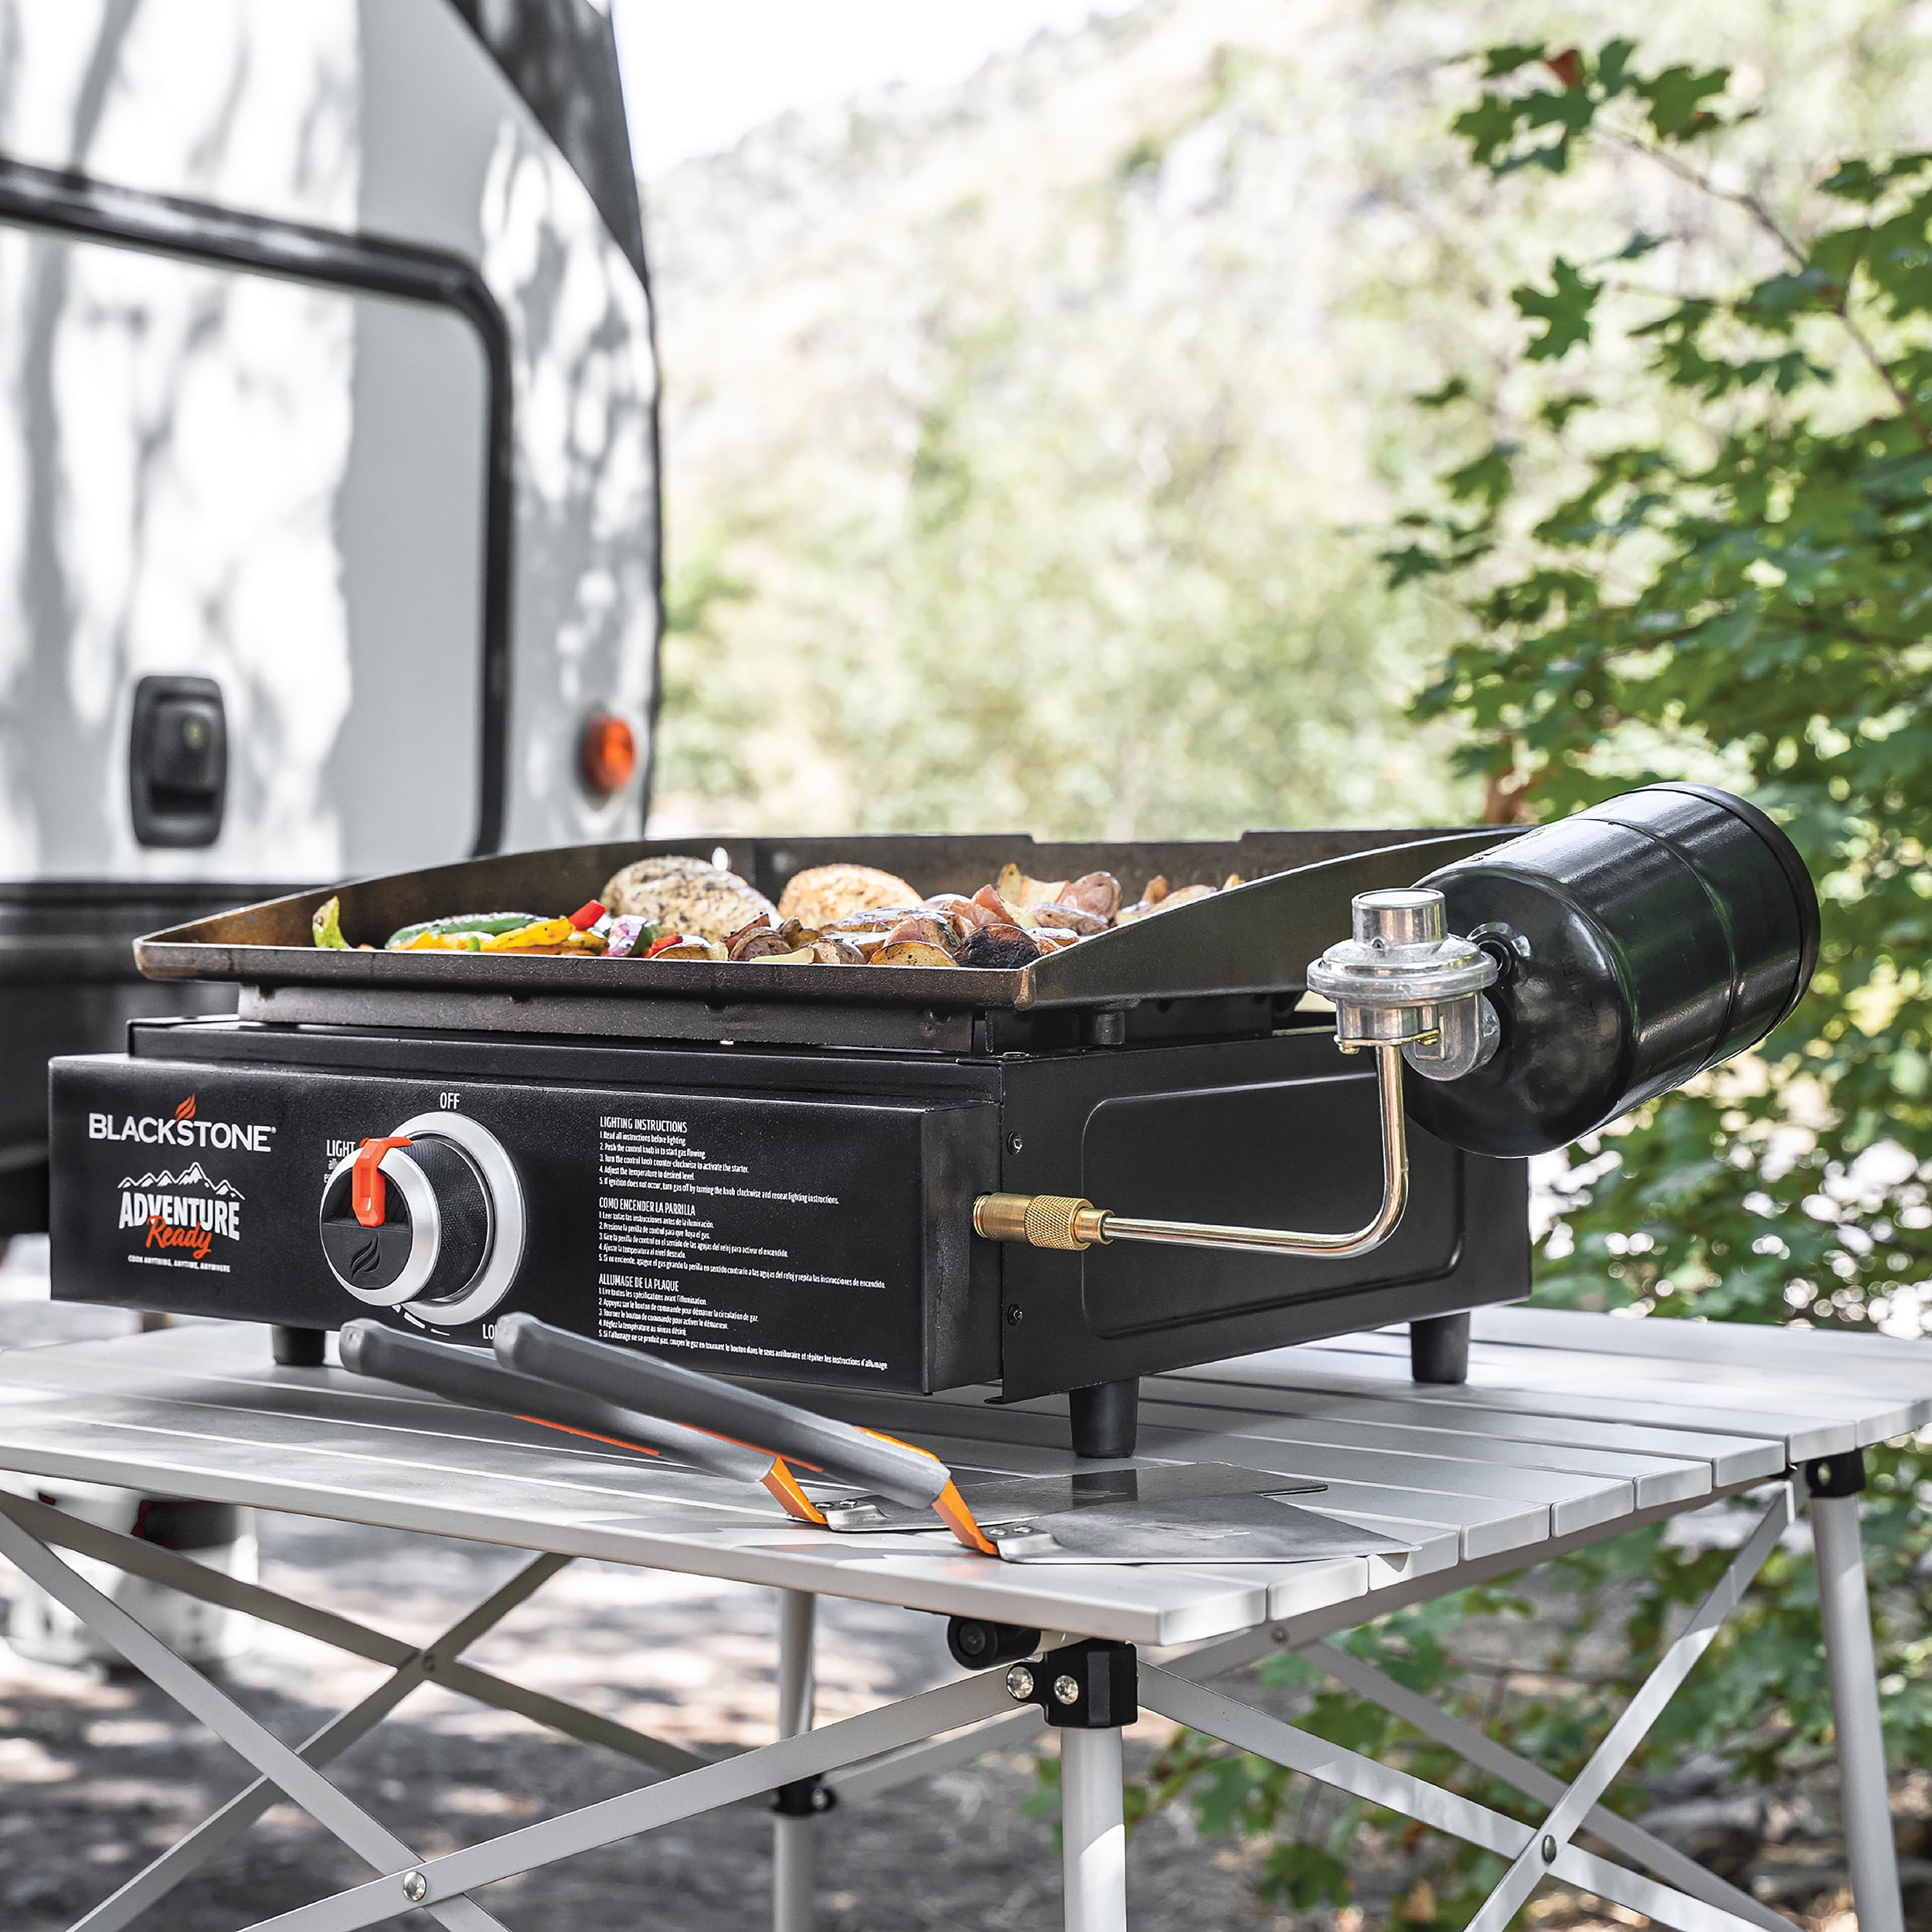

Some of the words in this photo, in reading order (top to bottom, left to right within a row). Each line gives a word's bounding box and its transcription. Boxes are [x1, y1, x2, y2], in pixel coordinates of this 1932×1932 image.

[440, 1092, 460, 1110] OFF
[89, 1113, 271, 1152] BLACKSTONE
[600, 1116, 633, 1129] LIGHTING
[634, 1119, 687, 1133] INSTRUCTIONS
[623, 1132, 650, 1142] instructions
[651, 1134, 666, 1143] before
[327, 1139, 356, 1157] LIGHT
[643, 1145, 654, 1154] knob
[678, 1150, 686, 1158] gas
[605, 1154, 614, 1162] Turn
[641, 1157, 652, 1165] knob
[731, 1165, 749, 1173] starter.
[604, 1166, 619, 1175] Adjust
[628, 1168, 657, 1178] temperature
[663, 1171, 682, 1179] desired
[689, 1184, 696, 1194] by
[696, 1185, 714, 1196] turning
[714, 1186, 723, 1195] the
[723, 1187, 735, 1196] knob
[736, 1188, 761, 1198] clockwise
[762, 1190, 771, 1199] and
[788, 1192, 808, 1204] lighting
[599, 1197, 618, 1209] COMO
[620, 1199, 654, 1212] ENCENDER
[655, 1202, 664, 1213] LA
[665, 1202, 696, 1216] PARRILLA
[118, 1191, 240, 1241] ADVENTURE
[604, 1223, 623, 1231] Presione
[145, 1216, 213, 1260] Ready
[604, 1243, 617, 1252] Ajuste
[623, 1246, 649, 1254] temperatura
[720, 1244, 730, 1253] reloj
[599, 1274, 633, 1287] ALLUMAGE
[634, 1277, 643, 1288] DE
[645, 1277, 652, 1289] LA
[654, 1279, 679, 1291] PLAQUE
[760, 1270, 774, 1279] agujas
[784, 1272, 794, 1281] reloj
[798, 1274, 812, 1282] repita
[821, 1274, 852, 1286] instrucciones
[603, 1298, 621, 1308] Appuyez
[635, 1301, 650, 1310] bouton
[604, 1308, 620, 1318] Tournez
[626, 1311, 641, 1320] bouton
[482, 1323, 497, 1339] LO
[669, 1338, 685, 1347] couper
[706, 1342, 724, 1351] tournant
[730, 1345, 747, 1353] bouton
[747, 1345, 758, 1355] dans
[832, 1357, 860, 1366] instructions
